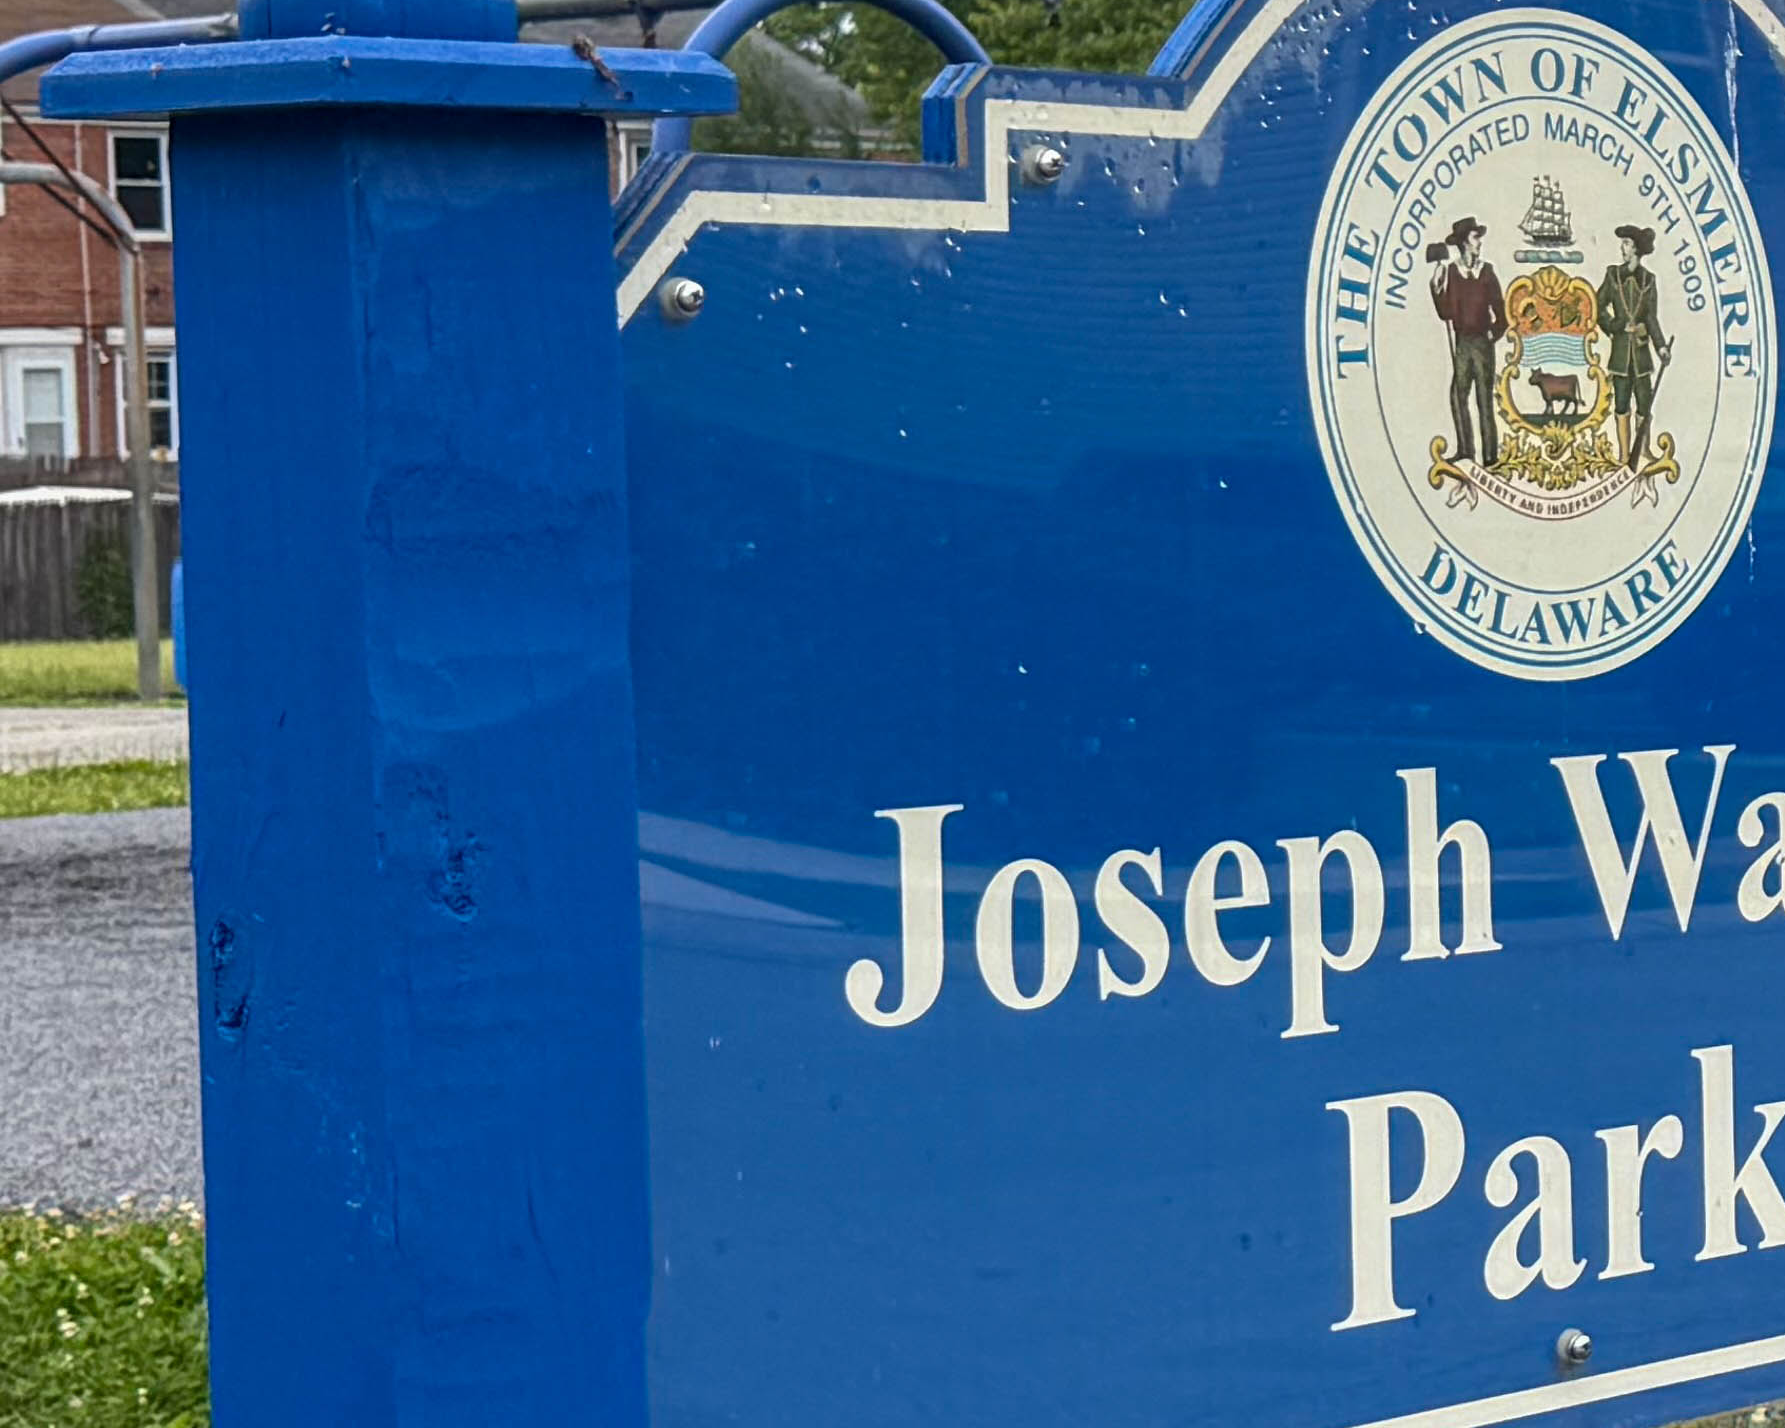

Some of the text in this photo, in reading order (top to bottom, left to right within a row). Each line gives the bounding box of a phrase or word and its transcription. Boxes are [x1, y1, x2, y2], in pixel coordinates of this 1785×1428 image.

[1336, 47, 1757, 379] THE TOWN OF ELSMERE
[1385, 112, 1706, 312] INCORPORATED MARCH 9TH 1909
[1471, 465, 1630, 515] LIBERTY AND INDEPENDENCE
[1418, 539, 1690, 645] DELAWARE
[845, 767, 1502, 1040] Joseph
